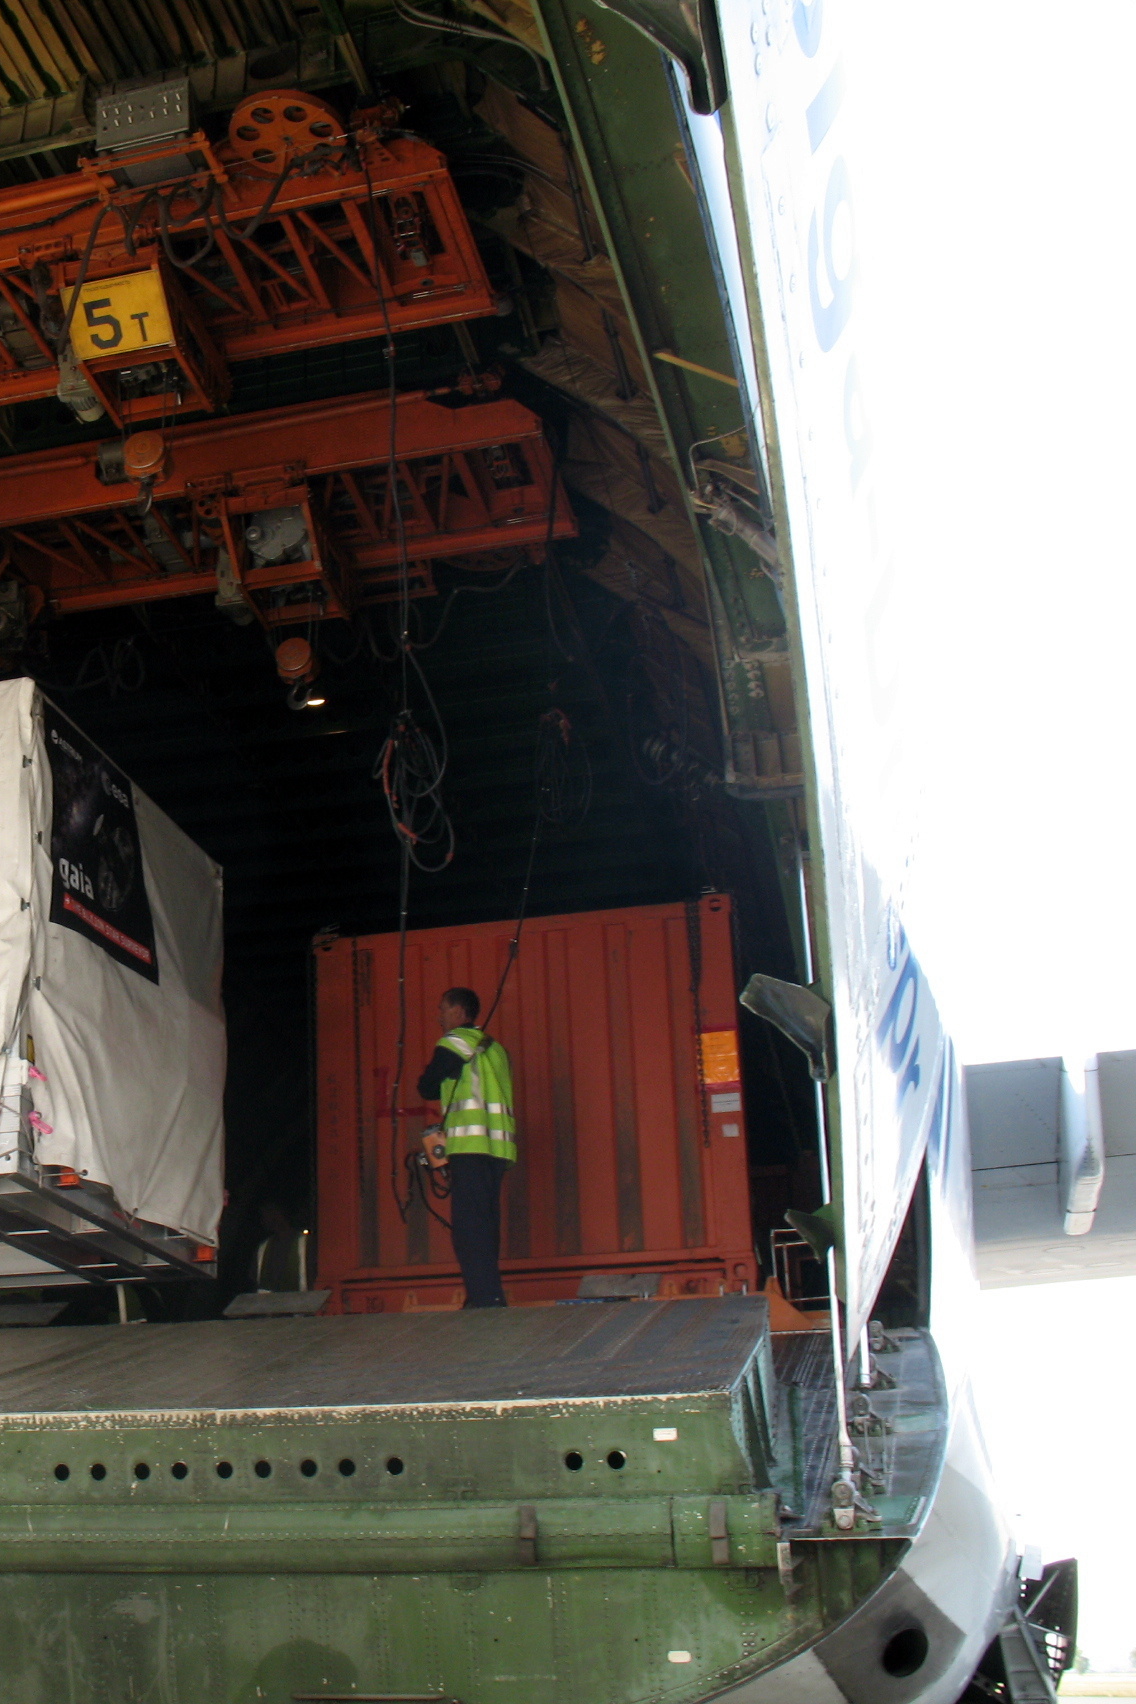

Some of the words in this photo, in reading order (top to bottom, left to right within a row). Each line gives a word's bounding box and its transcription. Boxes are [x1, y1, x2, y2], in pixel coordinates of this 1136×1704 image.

[83, 298, 123, 349] 5
[131, 312, 149, 342] T
[59, 858, 94, 900] gaia
